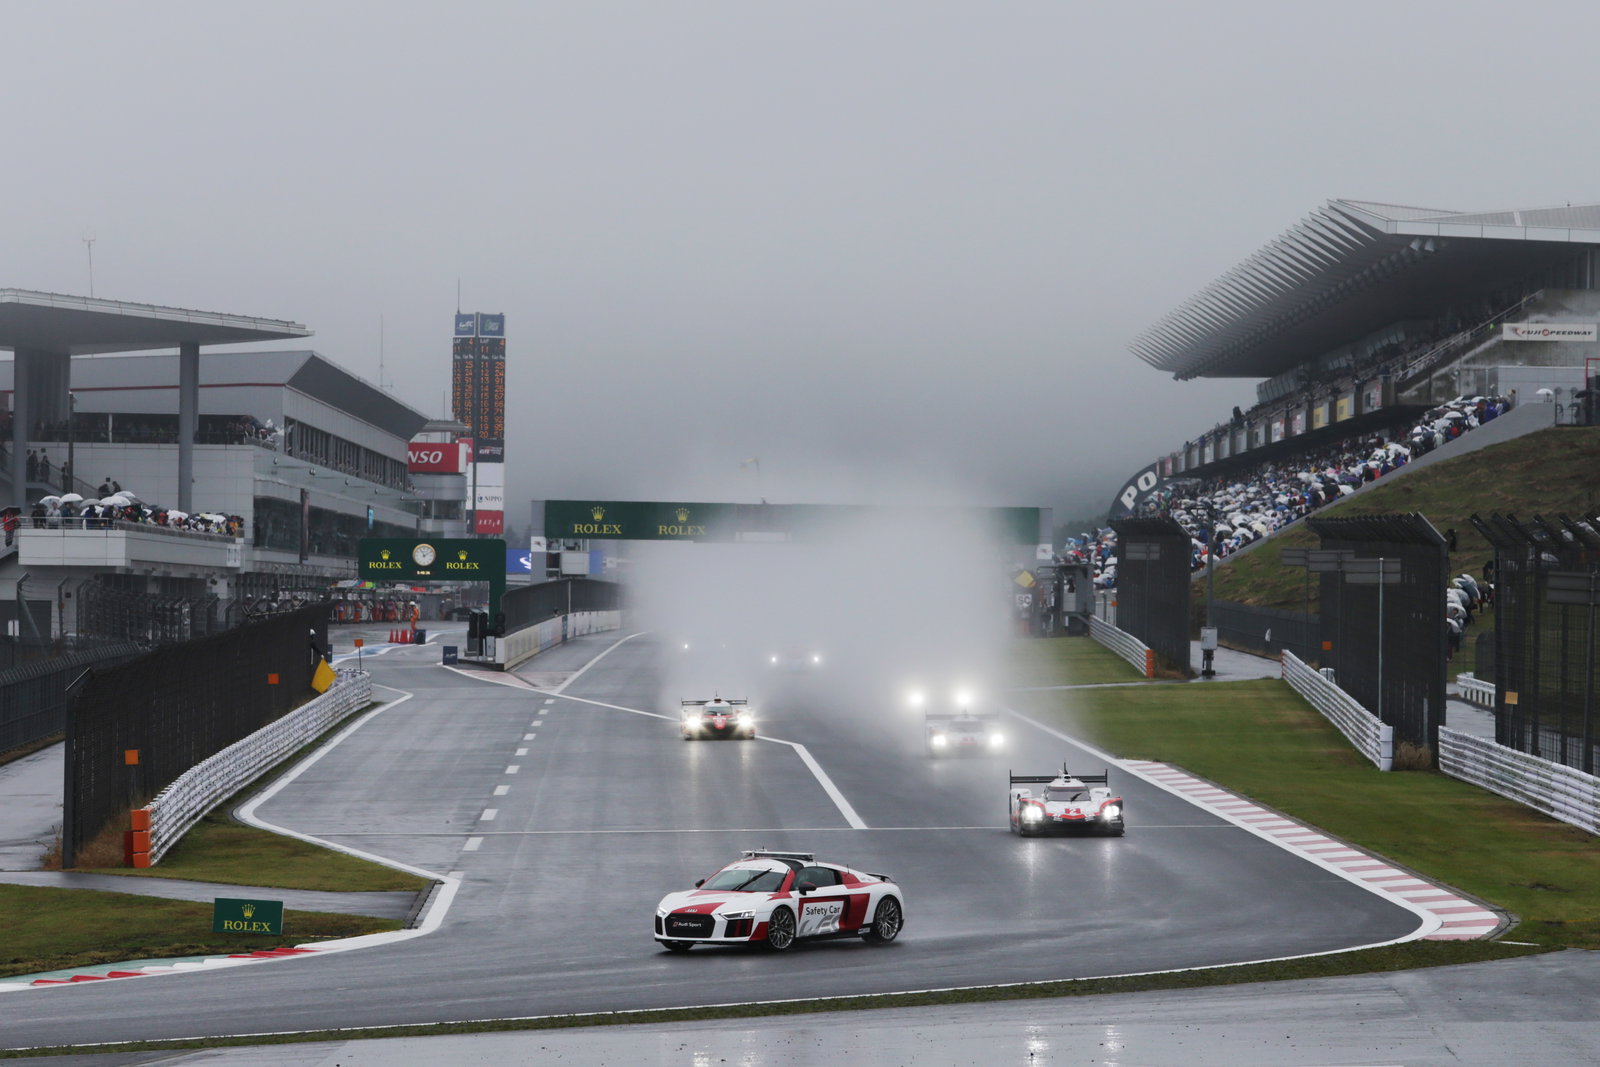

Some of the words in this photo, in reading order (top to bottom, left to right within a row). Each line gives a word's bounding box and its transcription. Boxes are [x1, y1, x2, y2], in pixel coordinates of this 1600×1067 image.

[574, 524, 622, 534] ROLEX
[658, 525, 706, 536] ROLEX
[1018, 596, 1031, 605] SC
[806, 906, 828, 916] Safety
[829, 905, 841, 914] Car
[224, 920, 271, 932] ROLEX
